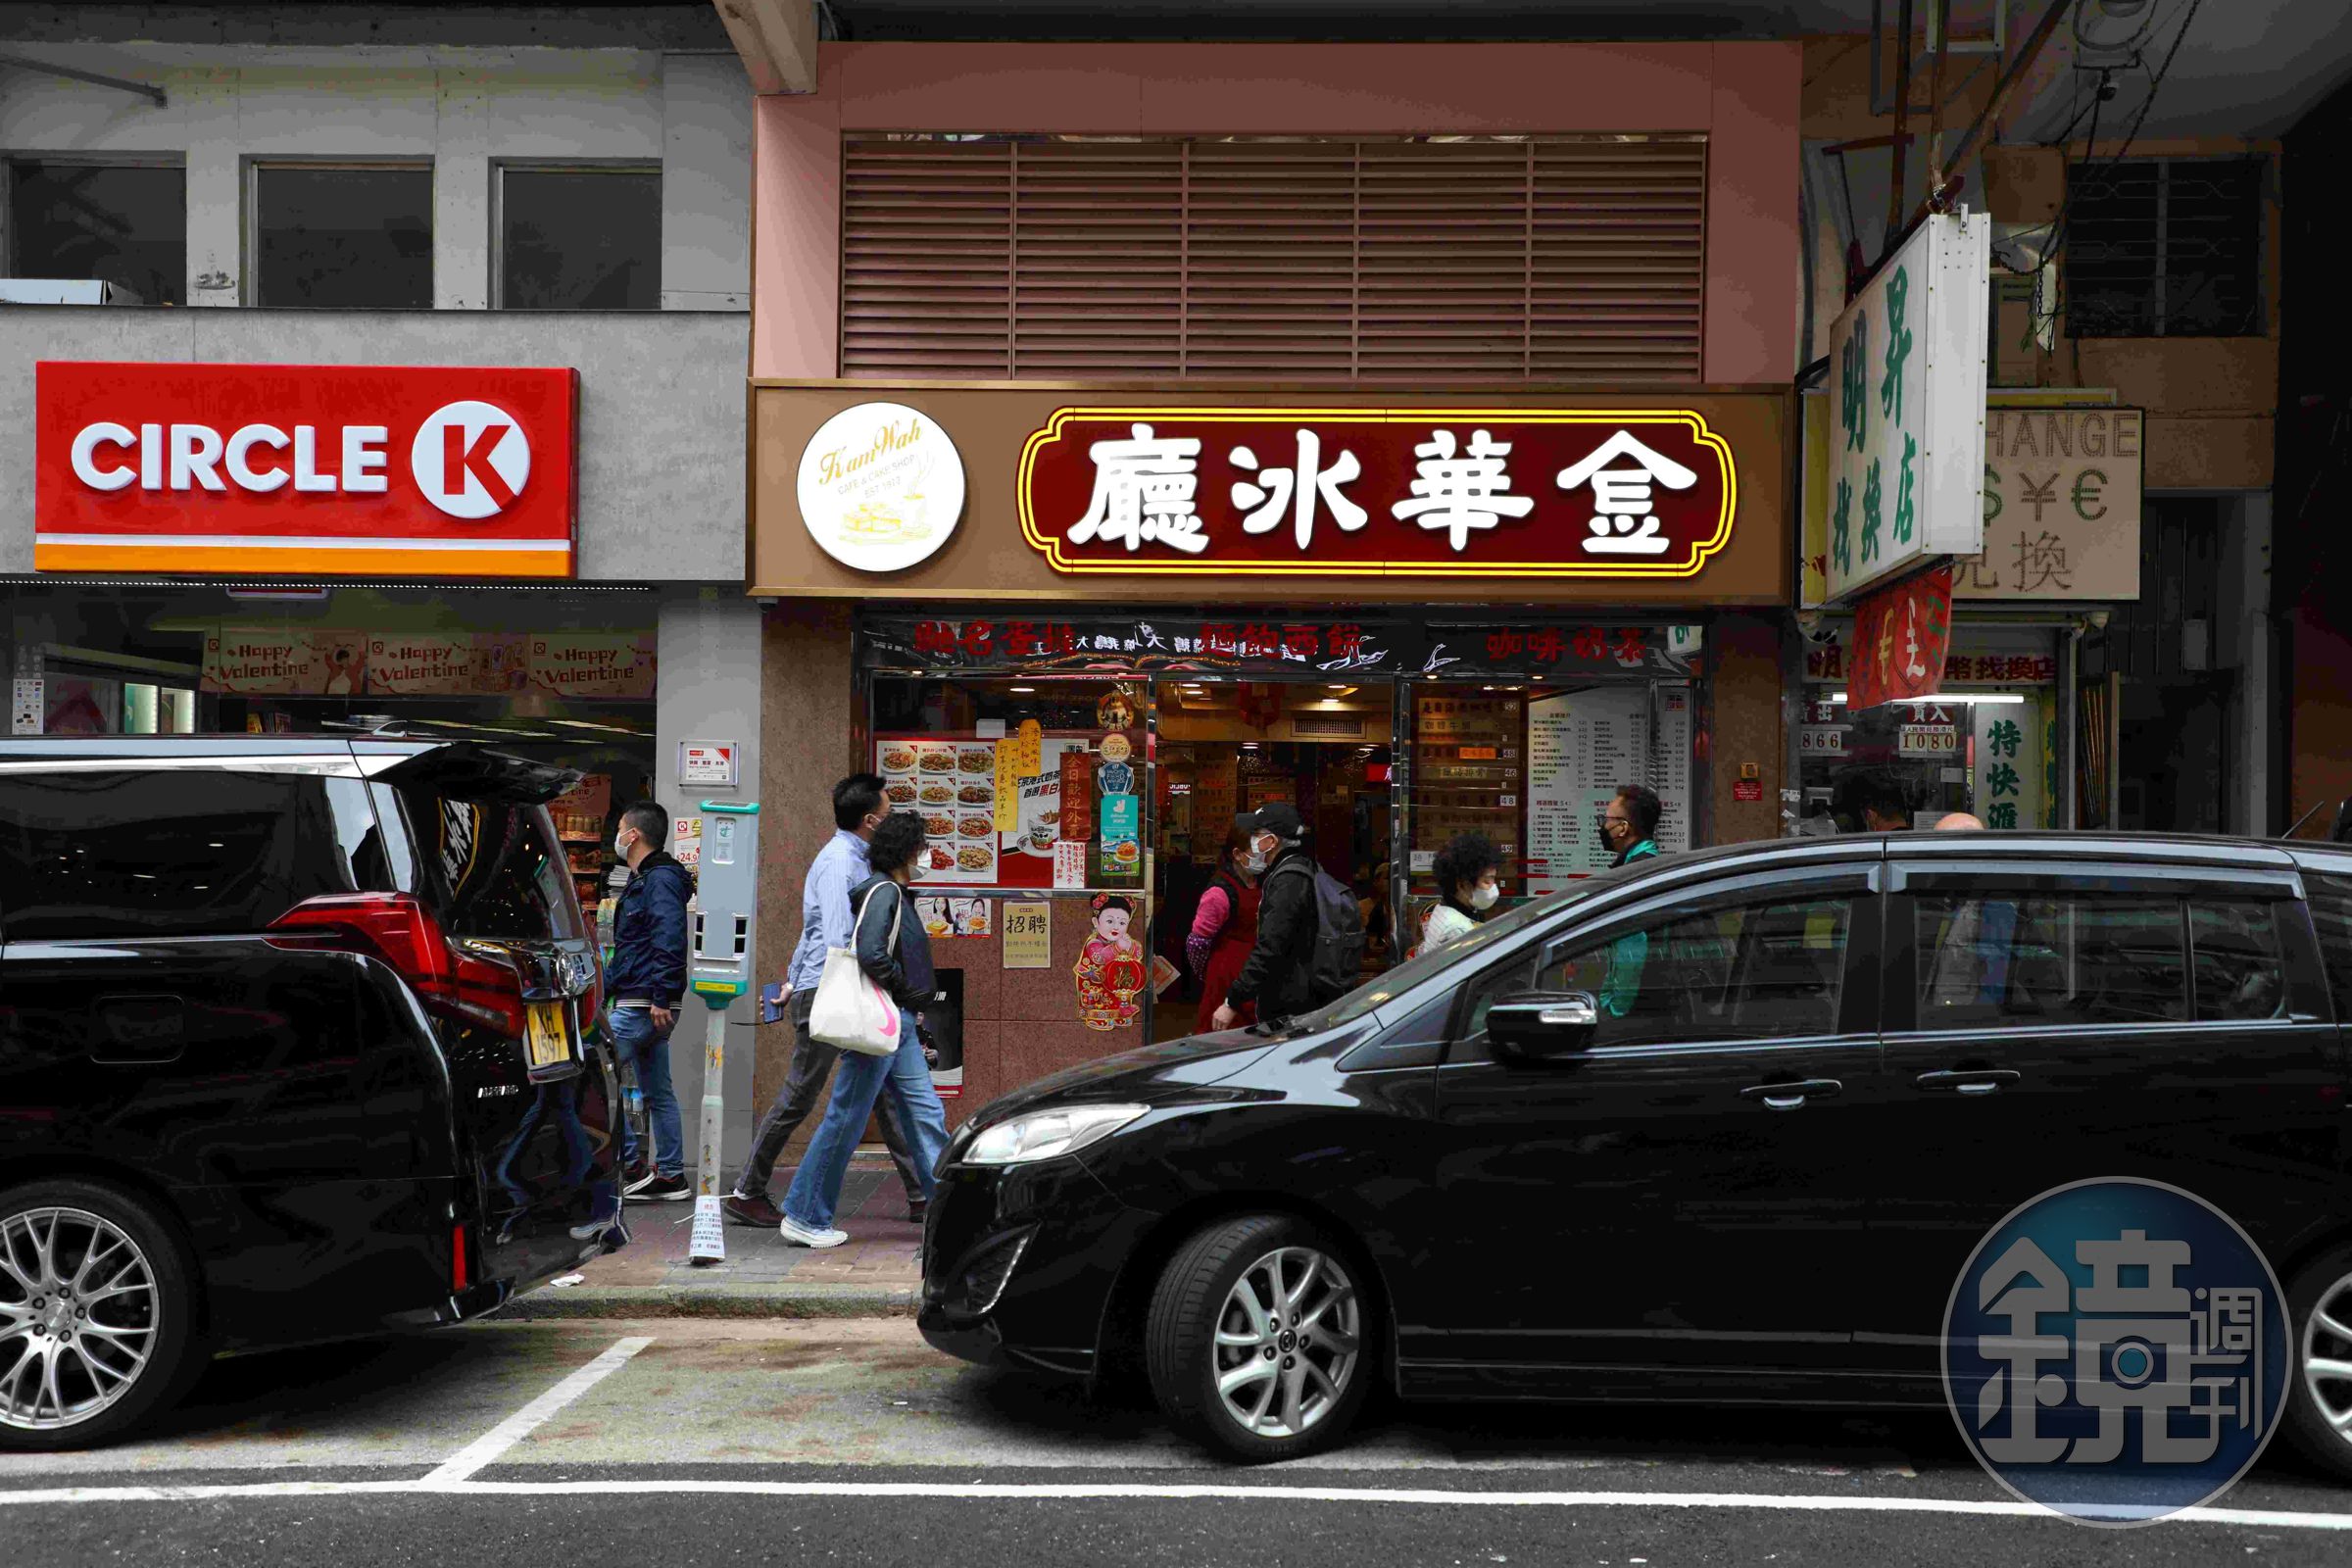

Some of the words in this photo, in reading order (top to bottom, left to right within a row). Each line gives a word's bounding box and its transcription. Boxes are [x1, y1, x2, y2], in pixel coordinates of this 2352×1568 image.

[818, 445, 877, 485] Kam
[874, 417, 923, 457] Wah
[72, 422, 388, 492] CIRCLE
[441, 421, 521, 514] K
[1833, 431, 1916, 576] 找換店
[239, 645, 293, 660] Happy
[401, 647, 452, 662] Happy
[564, 649, 617, 663] Happy
[220, 662, 309, 679] Valentine
[380, 662, 468, 682] Valentine
[545, 662, 634, 683] Valentine
[1913, 703, 1950, 722] 買入
[1903, 734, 1953, 750] 1080
[1024, 783, 1060, 799] 首選黑白
[1005, 914, 1047, 935] 招聘
